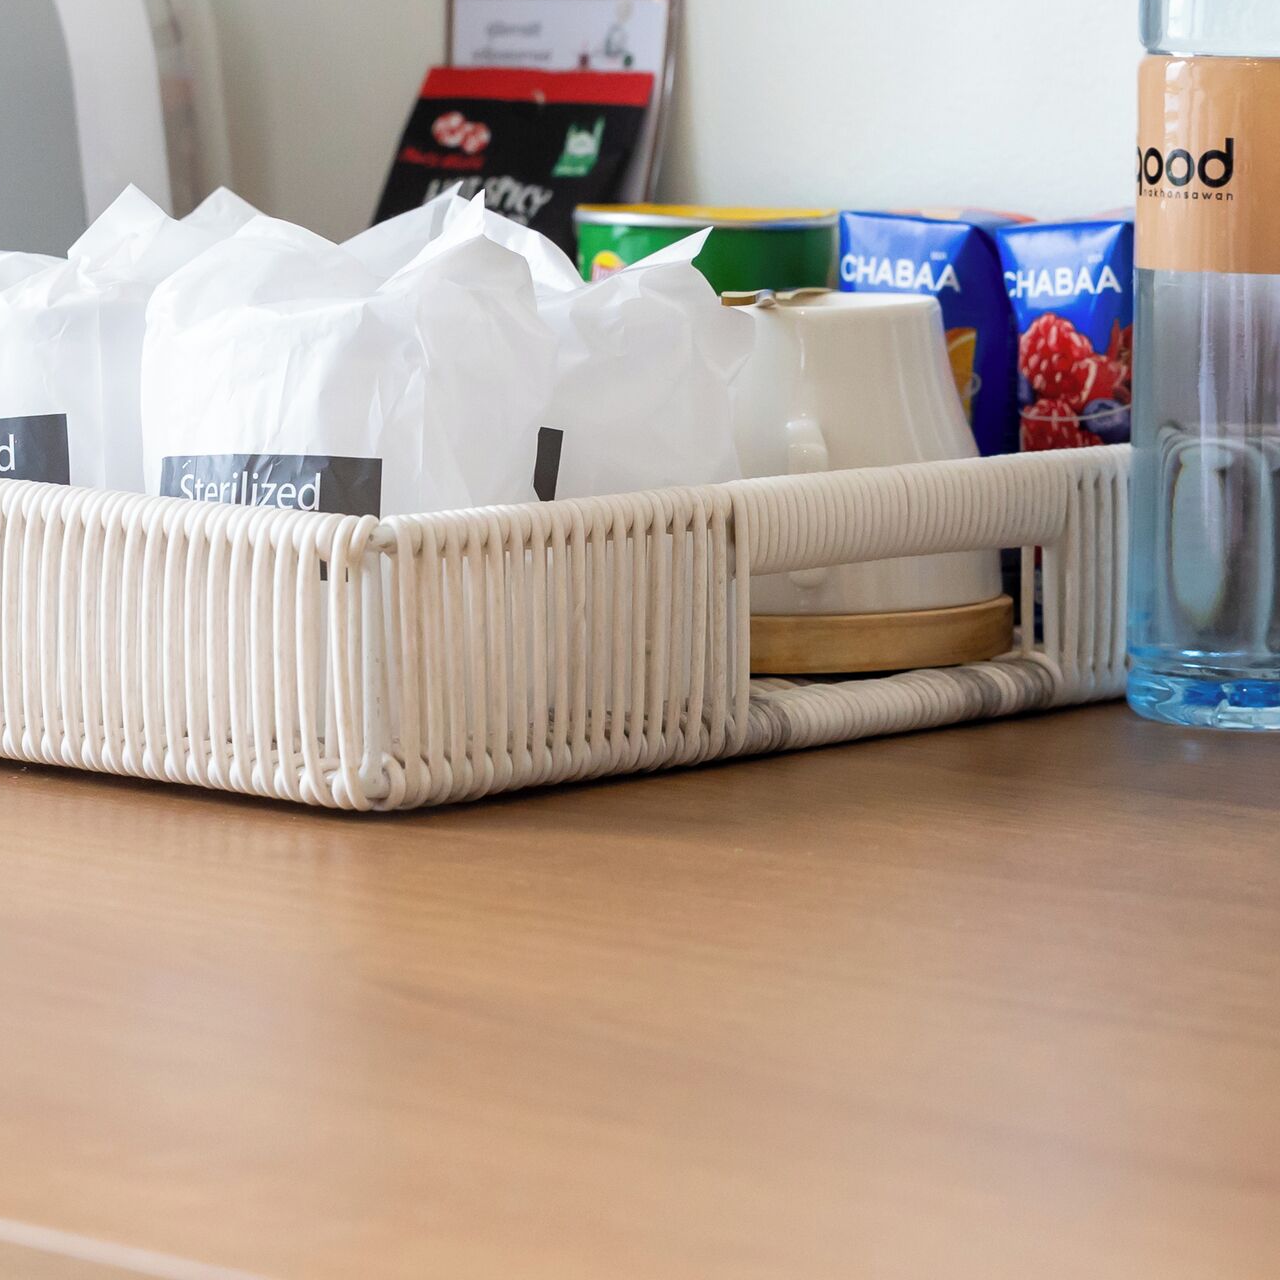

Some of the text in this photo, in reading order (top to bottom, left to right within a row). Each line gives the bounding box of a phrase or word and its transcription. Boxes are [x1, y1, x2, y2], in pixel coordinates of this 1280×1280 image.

[1144, 188, 1233, 200] nakhonsawan
[840, 254, 961, 292] CHABAA
[1004, 265, 1122, 299] CHABAA
[181, 471, 321, 511] Sterilized
